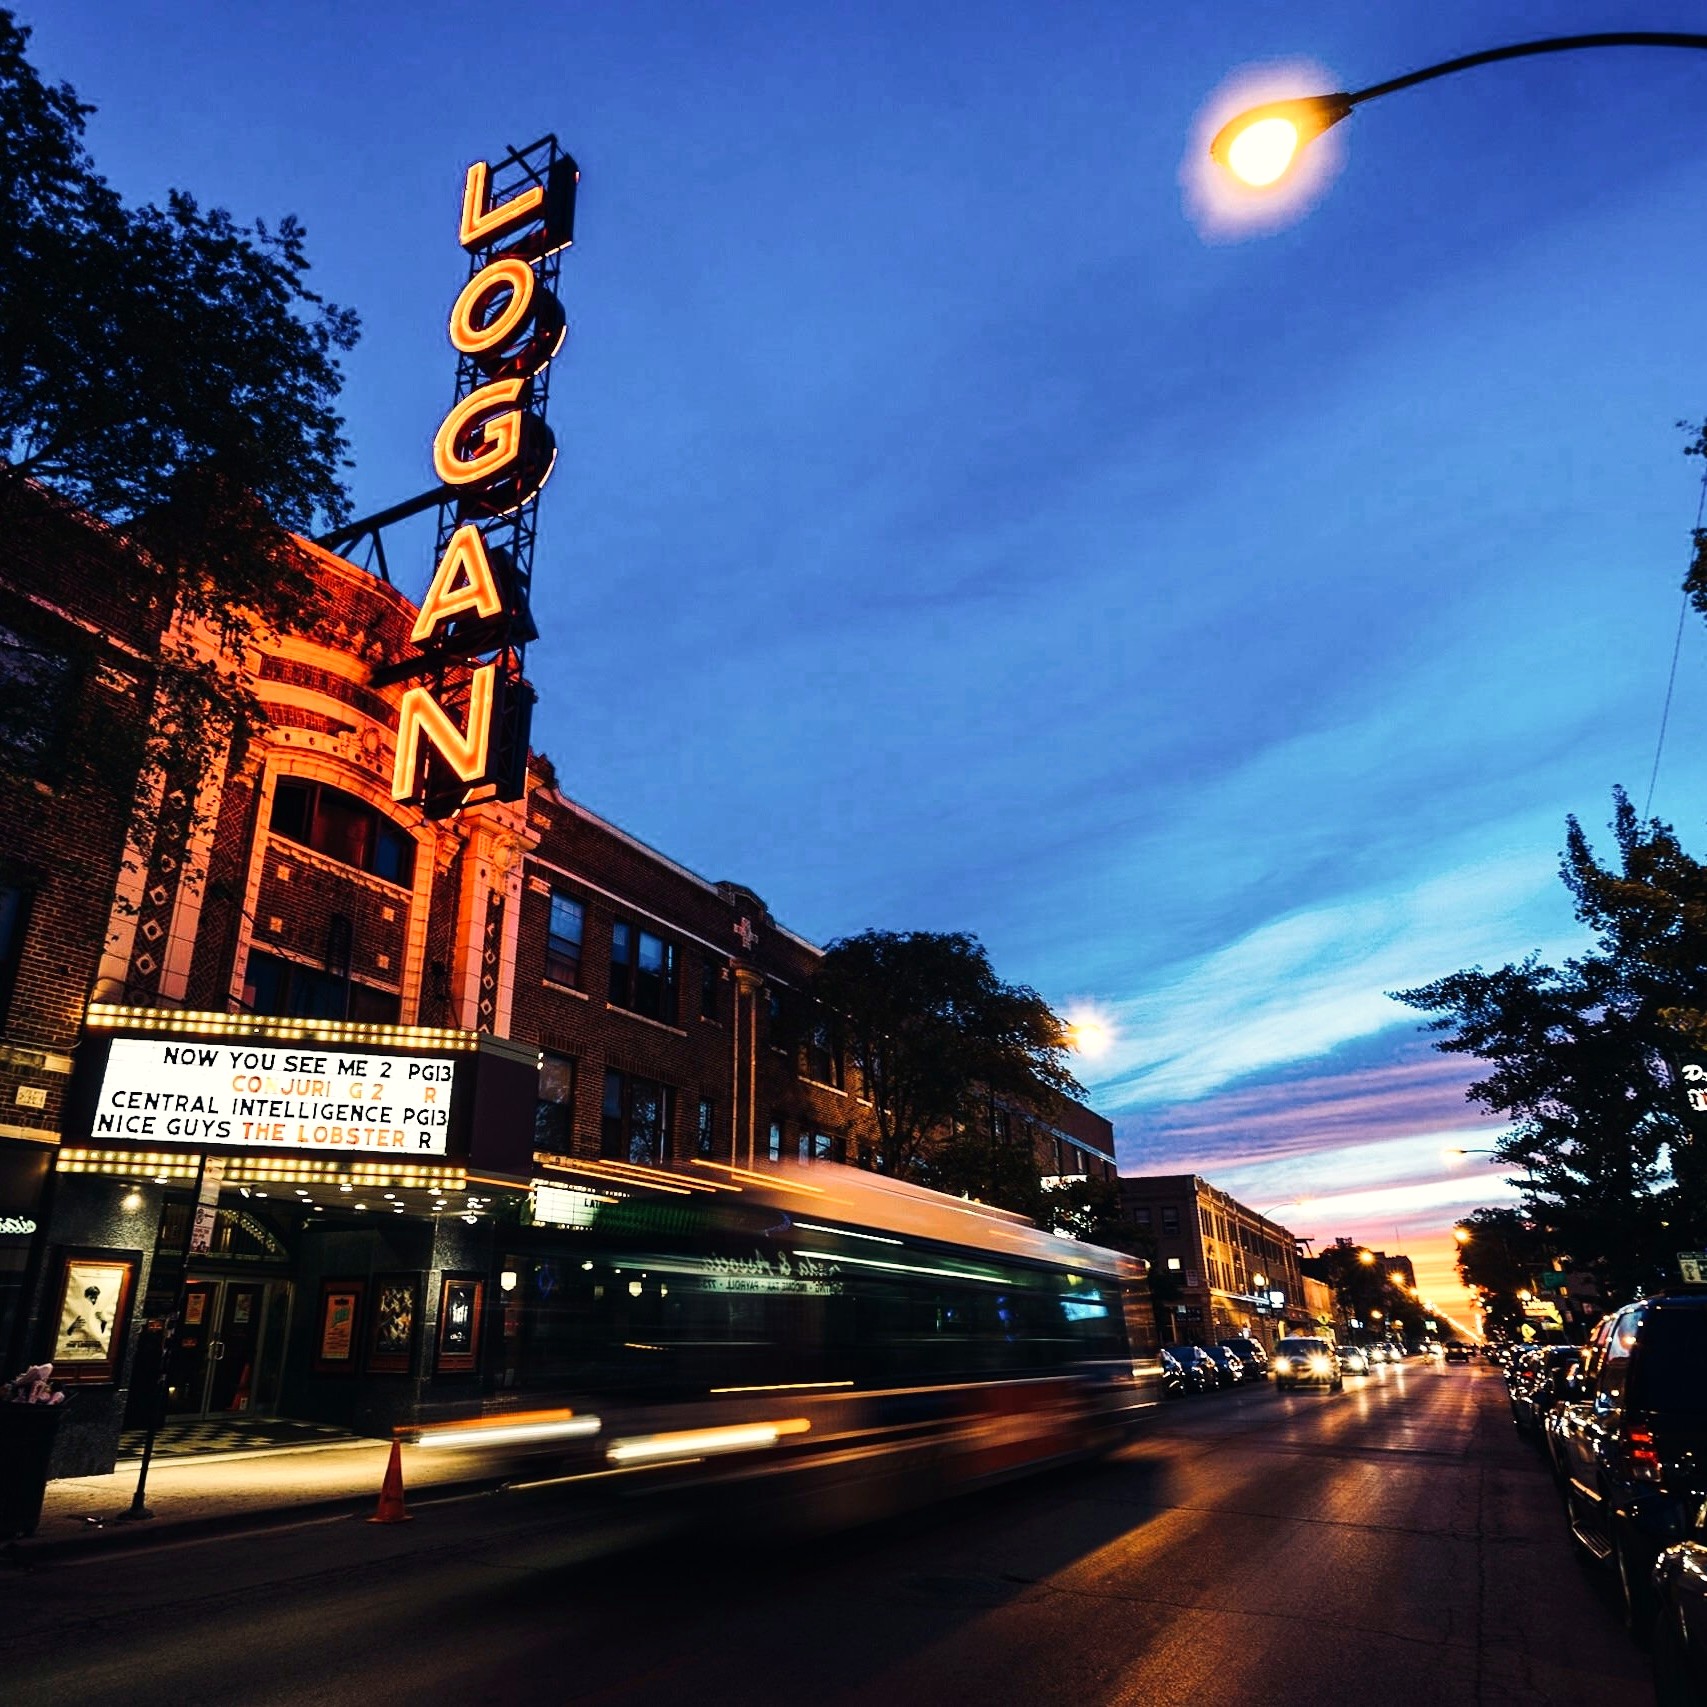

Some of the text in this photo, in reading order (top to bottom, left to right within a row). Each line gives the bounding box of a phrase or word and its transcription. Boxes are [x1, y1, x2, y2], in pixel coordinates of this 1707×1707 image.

[392, 161, 543, 801] LOGAN
[163, 1047, 451, 1082] NOW YOU SEE ME 2 PG13
[112, 1091, 447, 1126] CENTRAL INTELLIGENCE PG13
[371, 1084, 384, 1100] 2
[424, 1087, 436, 1103] R
[97, 1114, 431, 1148] NICE GUYS THE LOBSTER R
